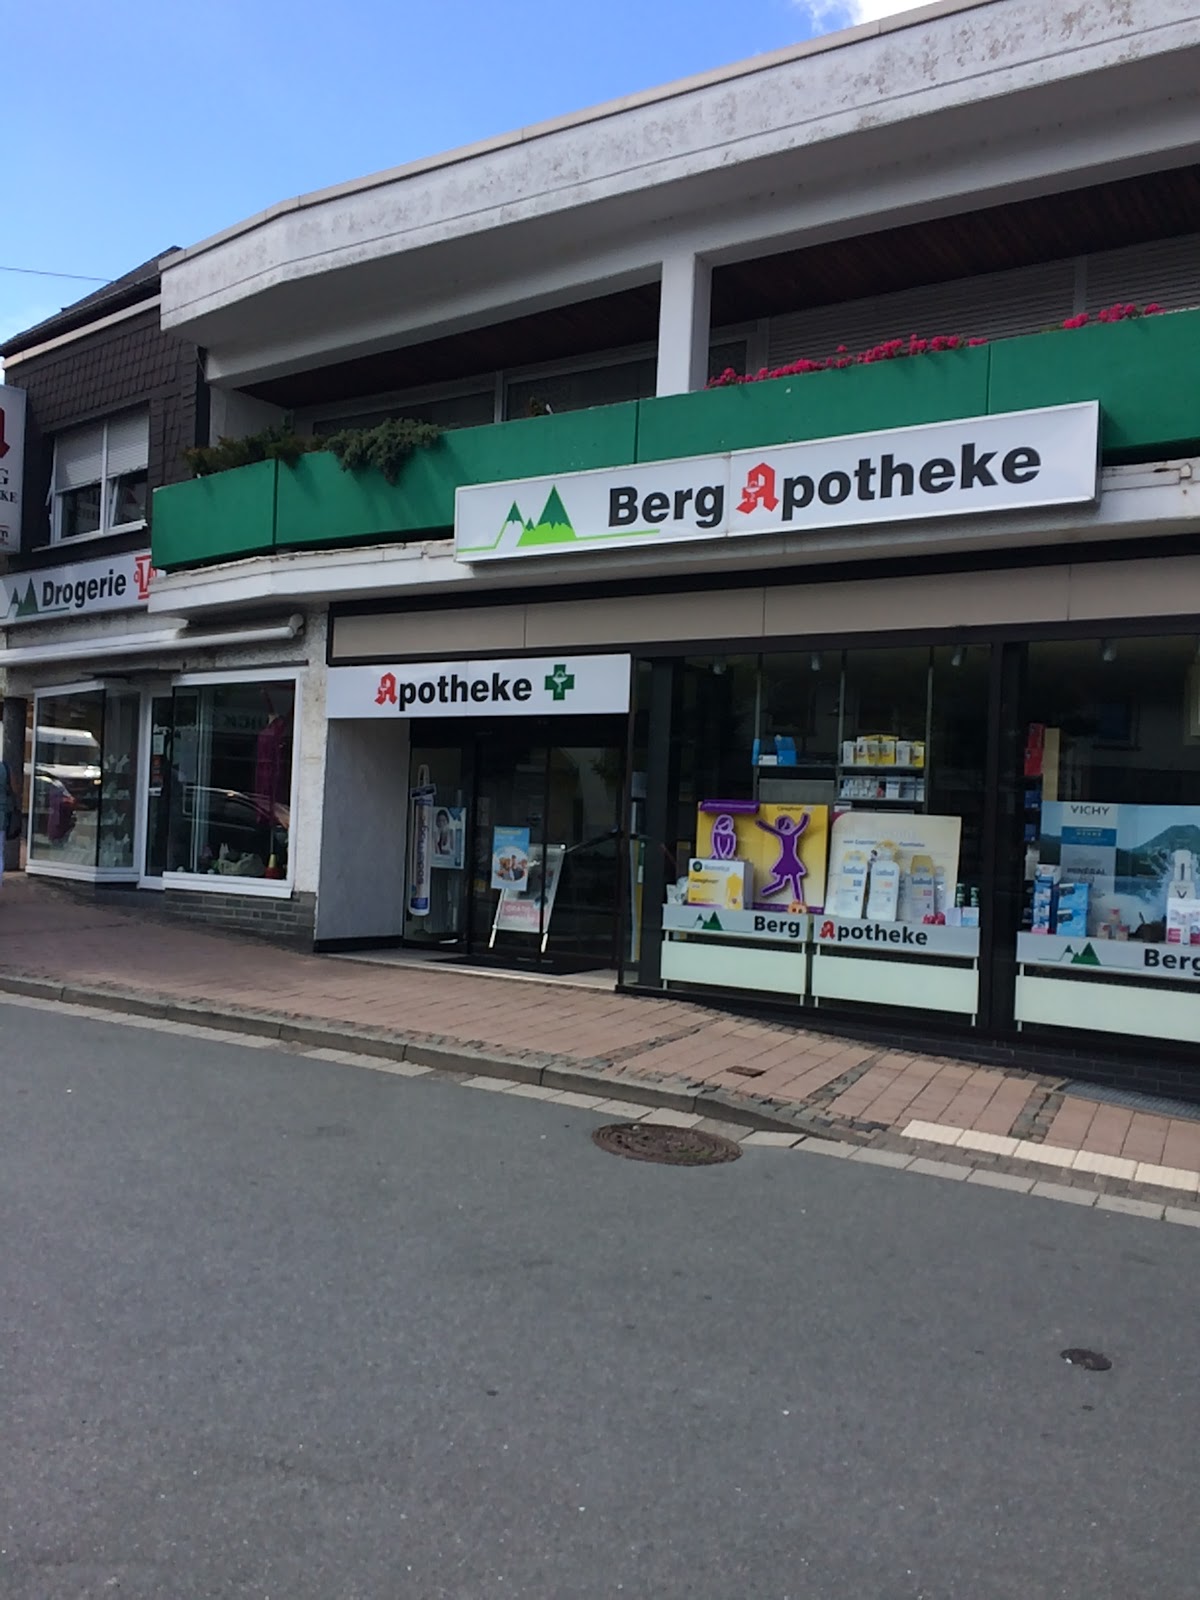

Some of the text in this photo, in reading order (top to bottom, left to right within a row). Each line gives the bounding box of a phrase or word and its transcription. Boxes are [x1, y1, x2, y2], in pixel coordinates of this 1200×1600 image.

[608, 442, 1042, 529] Berg Apotheke
[42, 568, 127, 608] Drogerie
[374, 672, 533, 712] Apotheke
[1070, 805, 1110, 816] VICHY
[754, 915, 928, 946] Berg Apotheke
